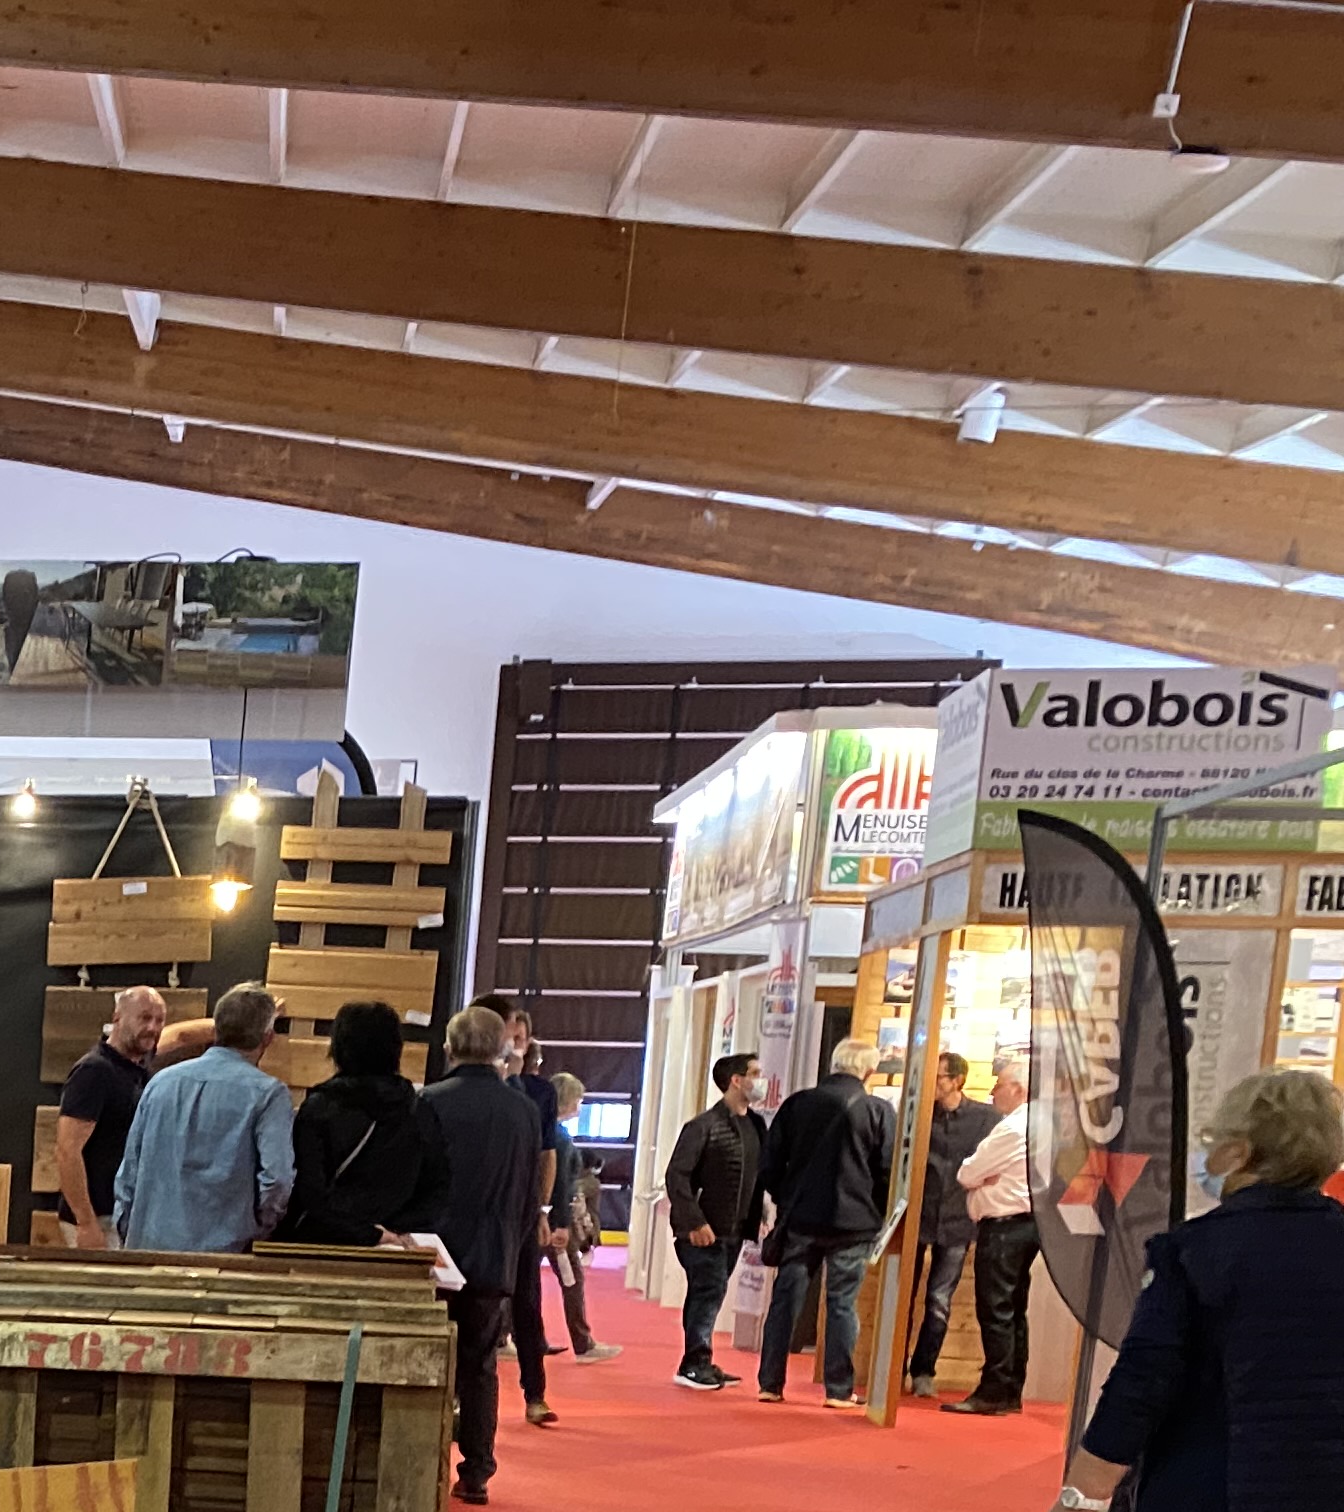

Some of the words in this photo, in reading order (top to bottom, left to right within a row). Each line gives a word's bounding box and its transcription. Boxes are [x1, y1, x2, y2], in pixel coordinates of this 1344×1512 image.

[1000, 671, 1290, 728] Valobois
[1086, 729, 1286, 753] constructions
[990, 768, 1019, 779] Rue
[1024, 768, 1043, 779] du
[1083, 768, 1102, 779] de
[988, 785, 1012, 798] 03
[1044, 785, 1068, 798] 24
[1073, 785, 1096, 798] 74
[1103, 785, 1123, 798] 11
